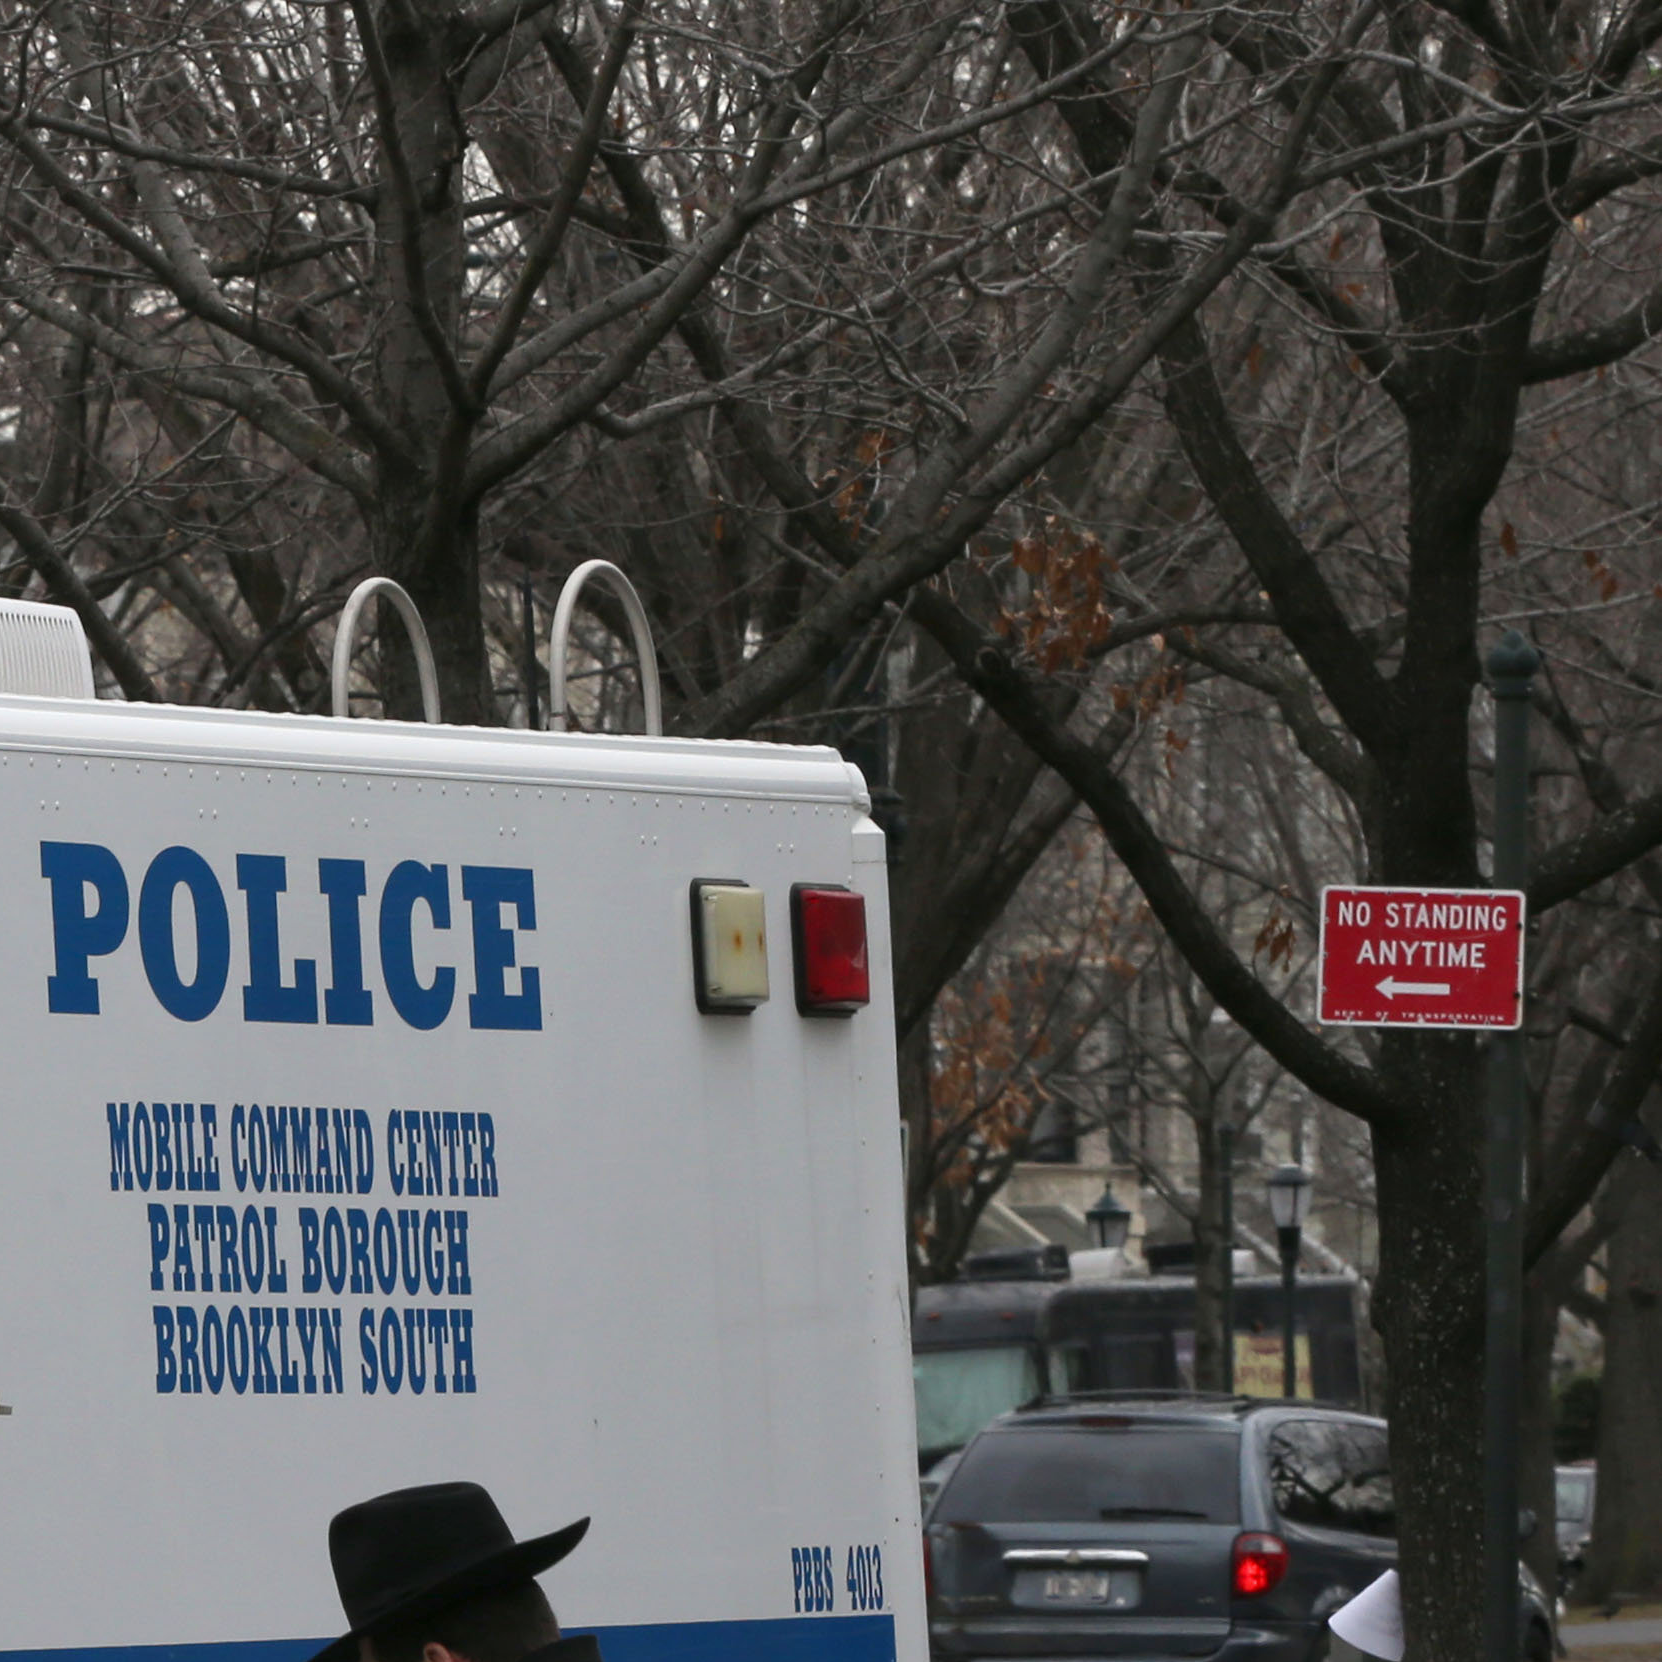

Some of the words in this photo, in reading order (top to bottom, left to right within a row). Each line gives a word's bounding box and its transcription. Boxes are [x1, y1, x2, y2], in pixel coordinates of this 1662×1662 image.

[40, 841, 543, 1031] POLICE
[1338, 901, 1372, 928] NO
[1385, 902, 1507, 932] STANDING
[1356, 939, 1486, 969] ANYTIME
[106, 1101, 221, 1193] MOBILE
[231, 1103, 375, 1195] COMMAND
[387, 1108, 500, 1198] CENTER
[148, 1202, 288, 1294] PATROL
[299, 1206, 473, 1297] BOROUGH
[152, 1304, 344, 1395] BROOKLYN
[359, 1306, 478, 1396] SOUTH
[791, 1545, 835, 1613] PBBS
[846, 1544, 884, 1612] 4013
